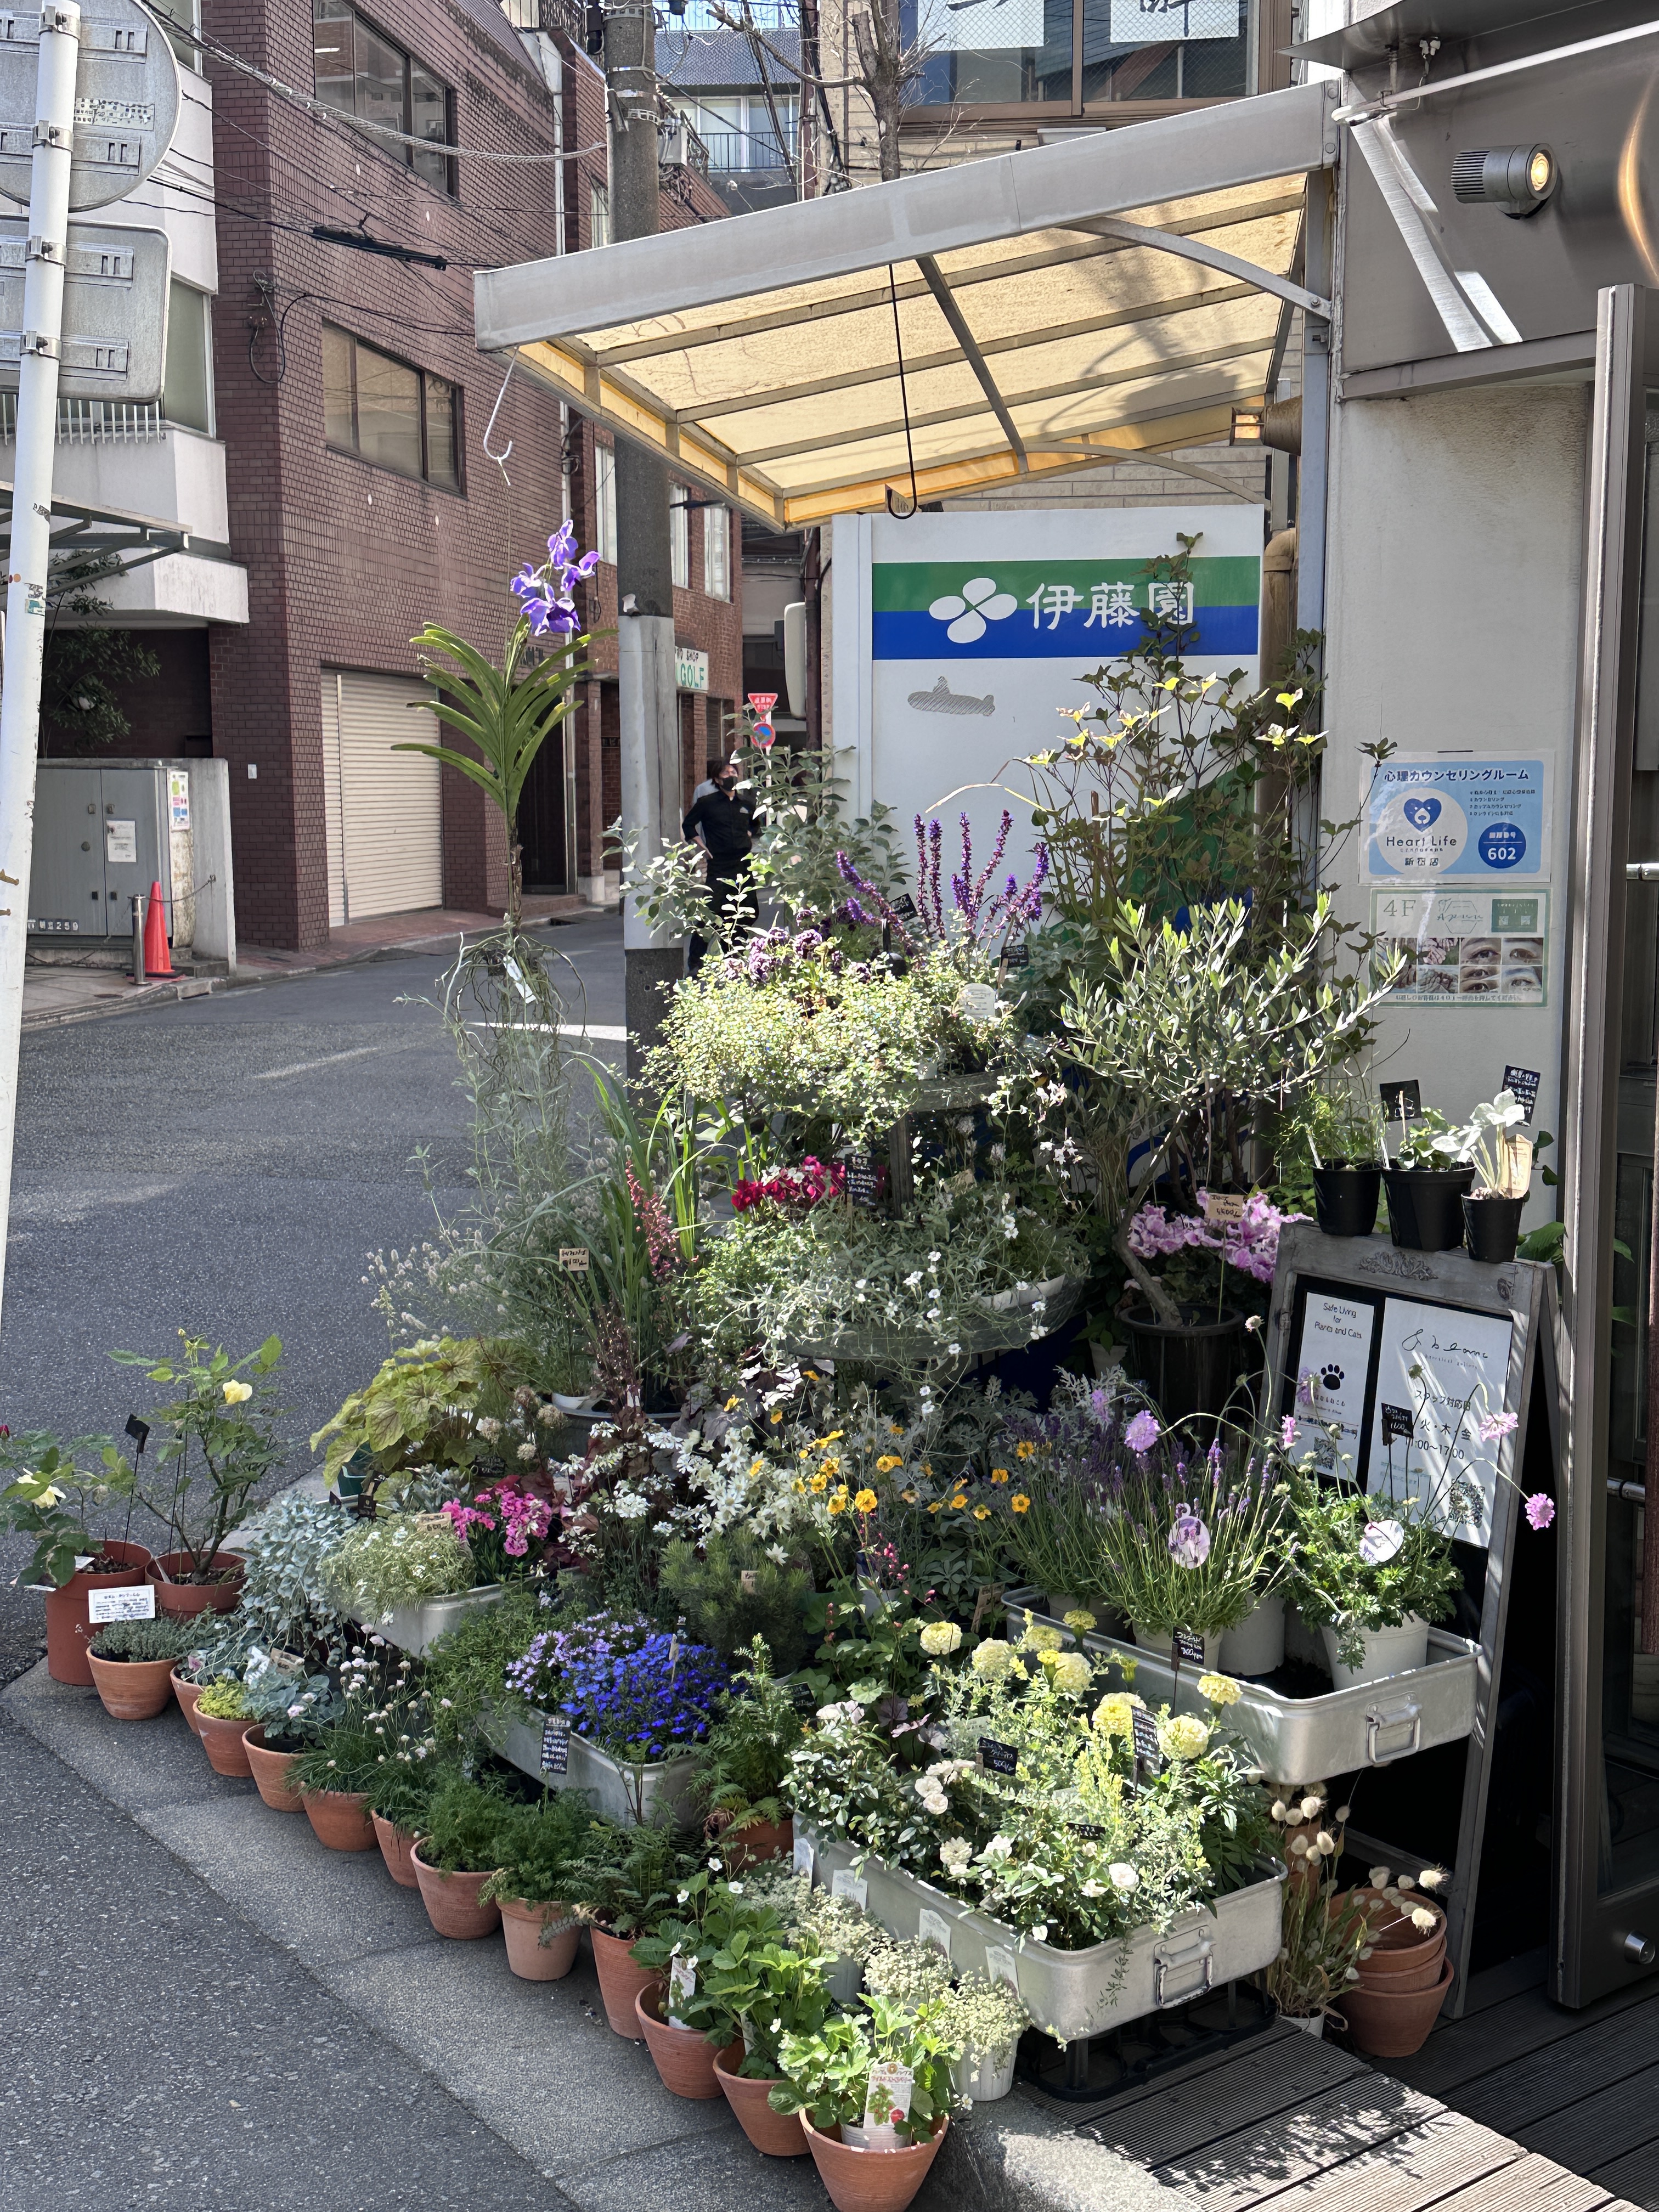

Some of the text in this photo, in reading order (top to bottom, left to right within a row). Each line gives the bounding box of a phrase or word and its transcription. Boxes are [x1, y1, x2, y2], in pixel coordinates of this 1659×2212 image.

[1026, 582, 1194, 630] 伊藤園
[680, 663, 704, 689] GOLF
[1384, 769, 1529, 782] 心理カウンセリングルーム
[1431, 834, 1457, 847] Life
[1487, 847, 1517, 861] 602
[1383, 899, 1417, 917] 4F
